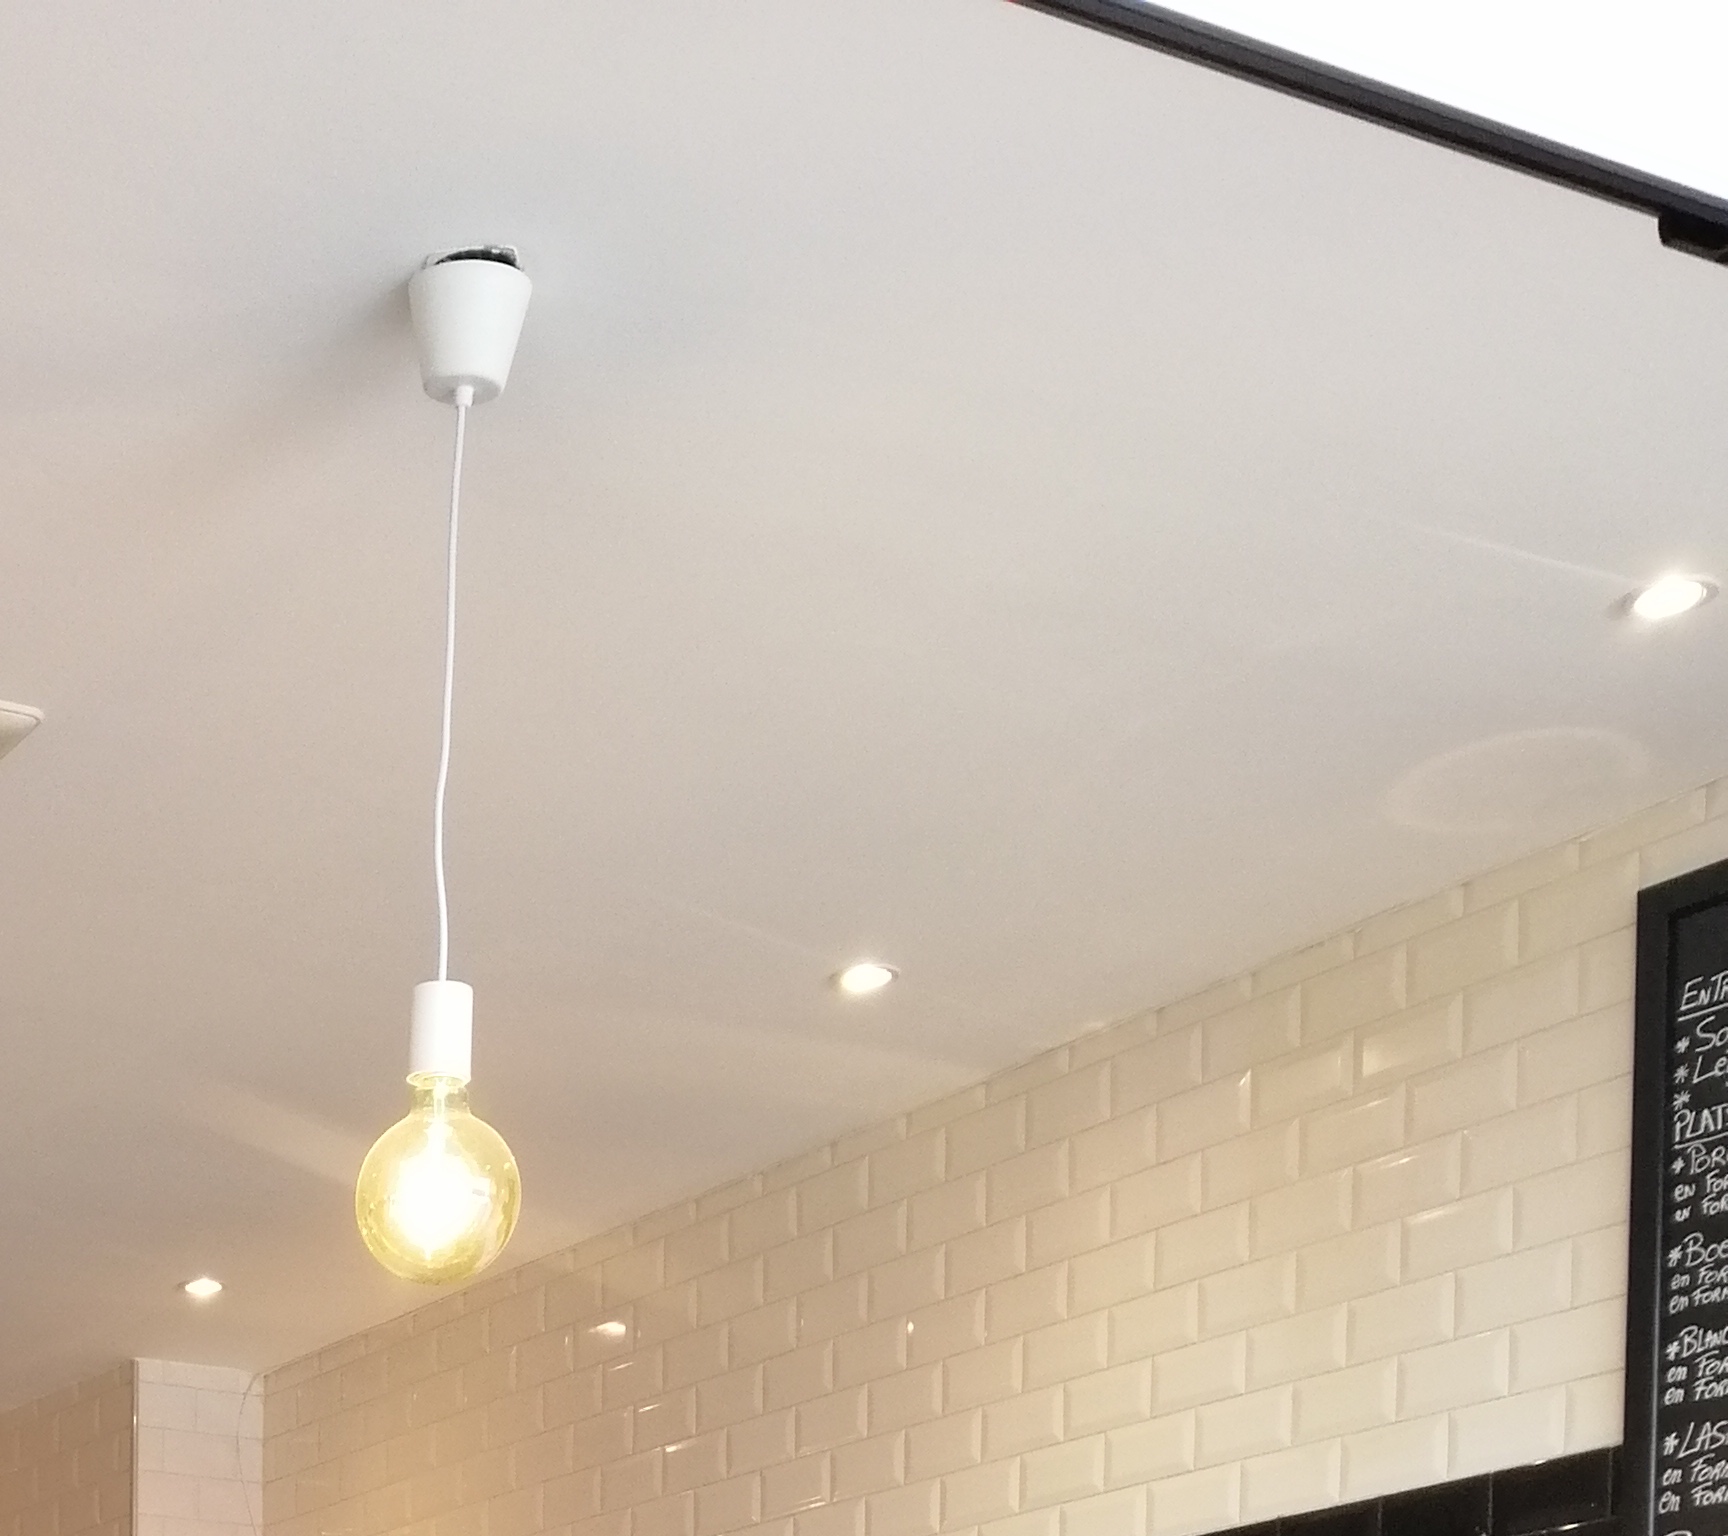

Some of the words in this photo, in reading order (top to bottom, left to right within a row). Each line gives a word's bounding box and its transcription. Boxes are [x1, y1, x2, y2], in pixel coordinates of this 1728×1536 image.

[1692, 1055, 1728, 1084] Le
[1673, 1103, 1728, 1143] PLAT
[1687, 1143, 1728, 1175] POR
[1676, 1420, 1728, 1459] LAS
[1690, 1481, 1728, 1507] FOR
